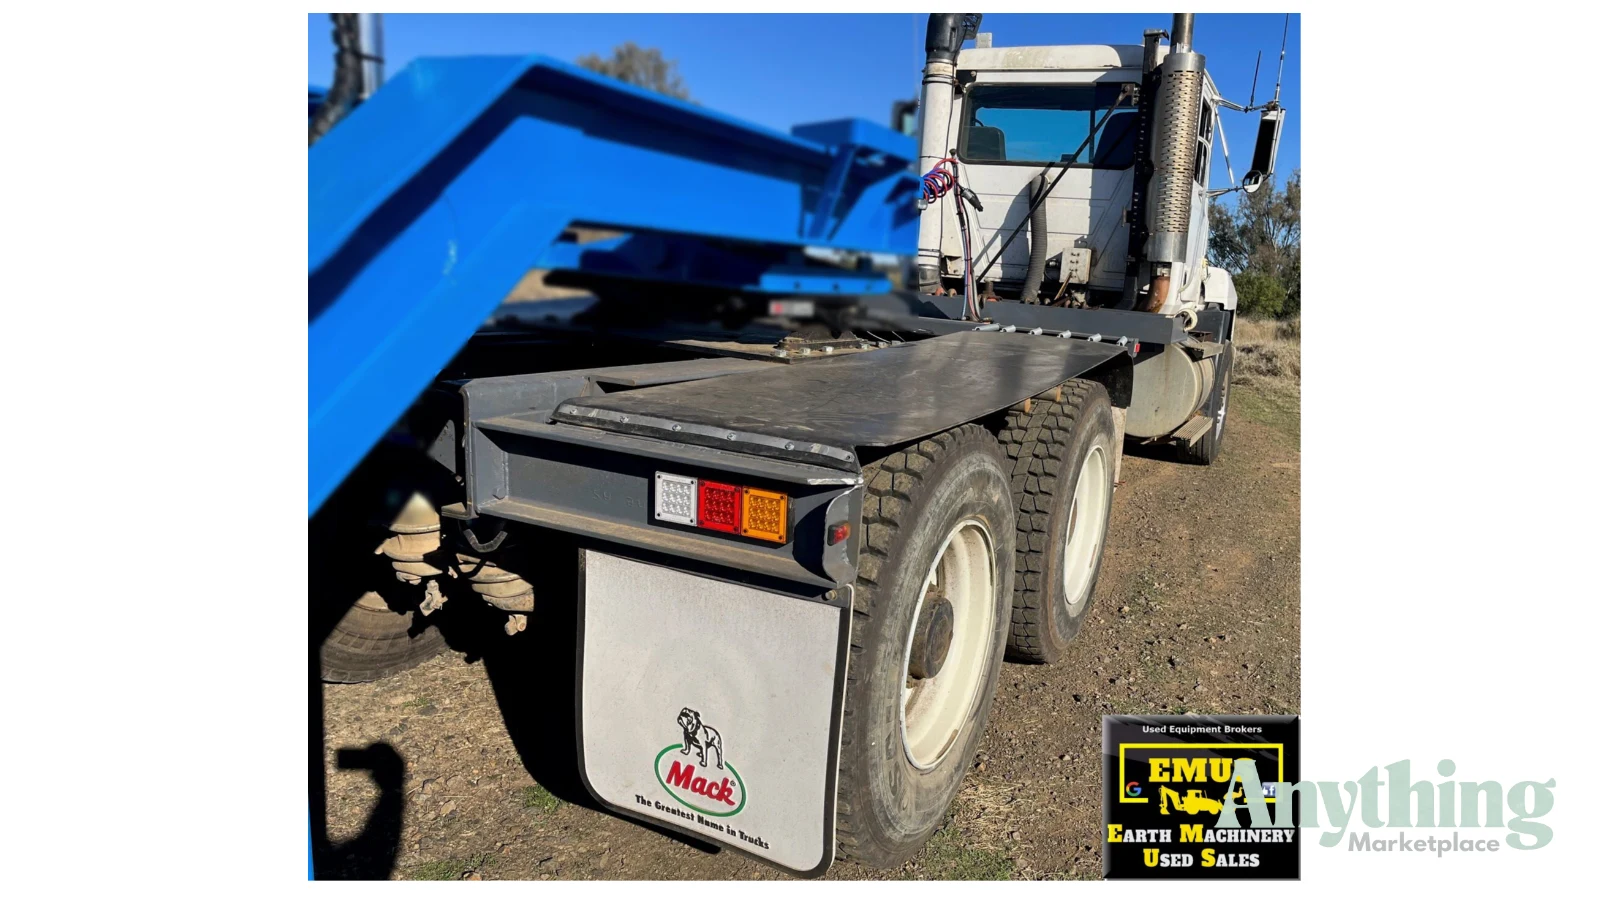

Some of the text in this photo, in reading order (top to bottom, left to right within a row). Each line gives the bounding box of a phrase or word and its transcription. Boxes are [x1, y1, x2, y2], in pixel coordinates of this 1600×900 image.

[665, 760, 735, 806] Mack
[635, 794, 770, 850] The Greatest Name in Trucks
